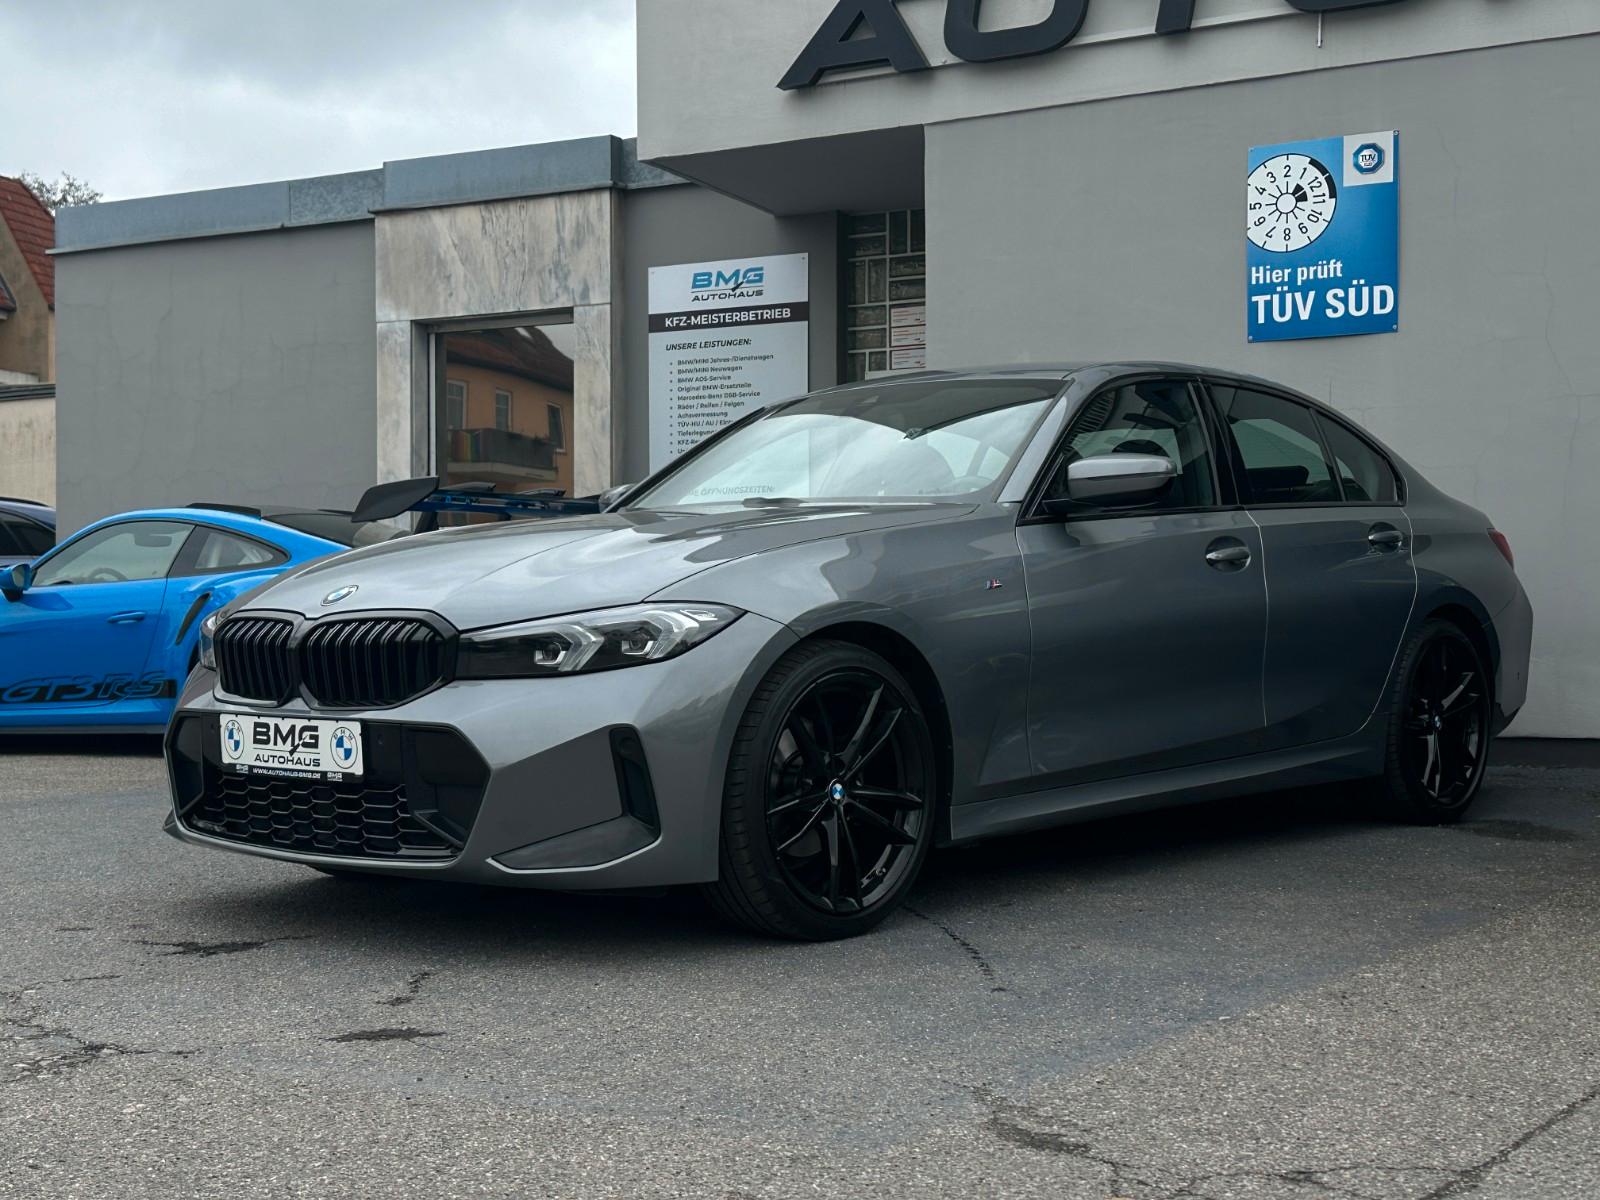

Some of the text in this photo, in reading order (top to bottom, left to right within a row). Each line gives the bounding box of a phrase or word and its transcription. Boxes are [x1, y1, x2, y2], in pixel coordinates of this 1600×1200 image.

[1266, 171, 1277, 184] 3
[1283, 165, 1292, 178] 2
[1299, 167, 1308, 180] 1
[1254, 185, 1267, 196] 4
[1307, 176, 1323, 192] 12
[1312, 192, 1326, 205] 11
[1249, 202, 1262, 211] 5
[1253, 215, 1266, 228] 6
[1306, 209, 1323, 224] 10
[1265, 226, 1277, 239] 7
[1283, 227, 1291, 241] 8
[1298, 222, 1309, 235] 9
[691, 266, 764, 290] BMG
[1251, 259, 1343, 286] Hier prüft
[691, 289, 764, 302] AUTOHAUS
[1251, 279, 1395, 325] TÜV SÜD
[665, 308, 791, 328] KFZ-MEISTERBETRIEB
[666, 338, 752, 351] UNSERE LEISTUNGEN:
[677, 385, 700, 393] Original
[252, 721, 320, 750] BMG
[254, 753, 321, 767] AUTOHAUS
